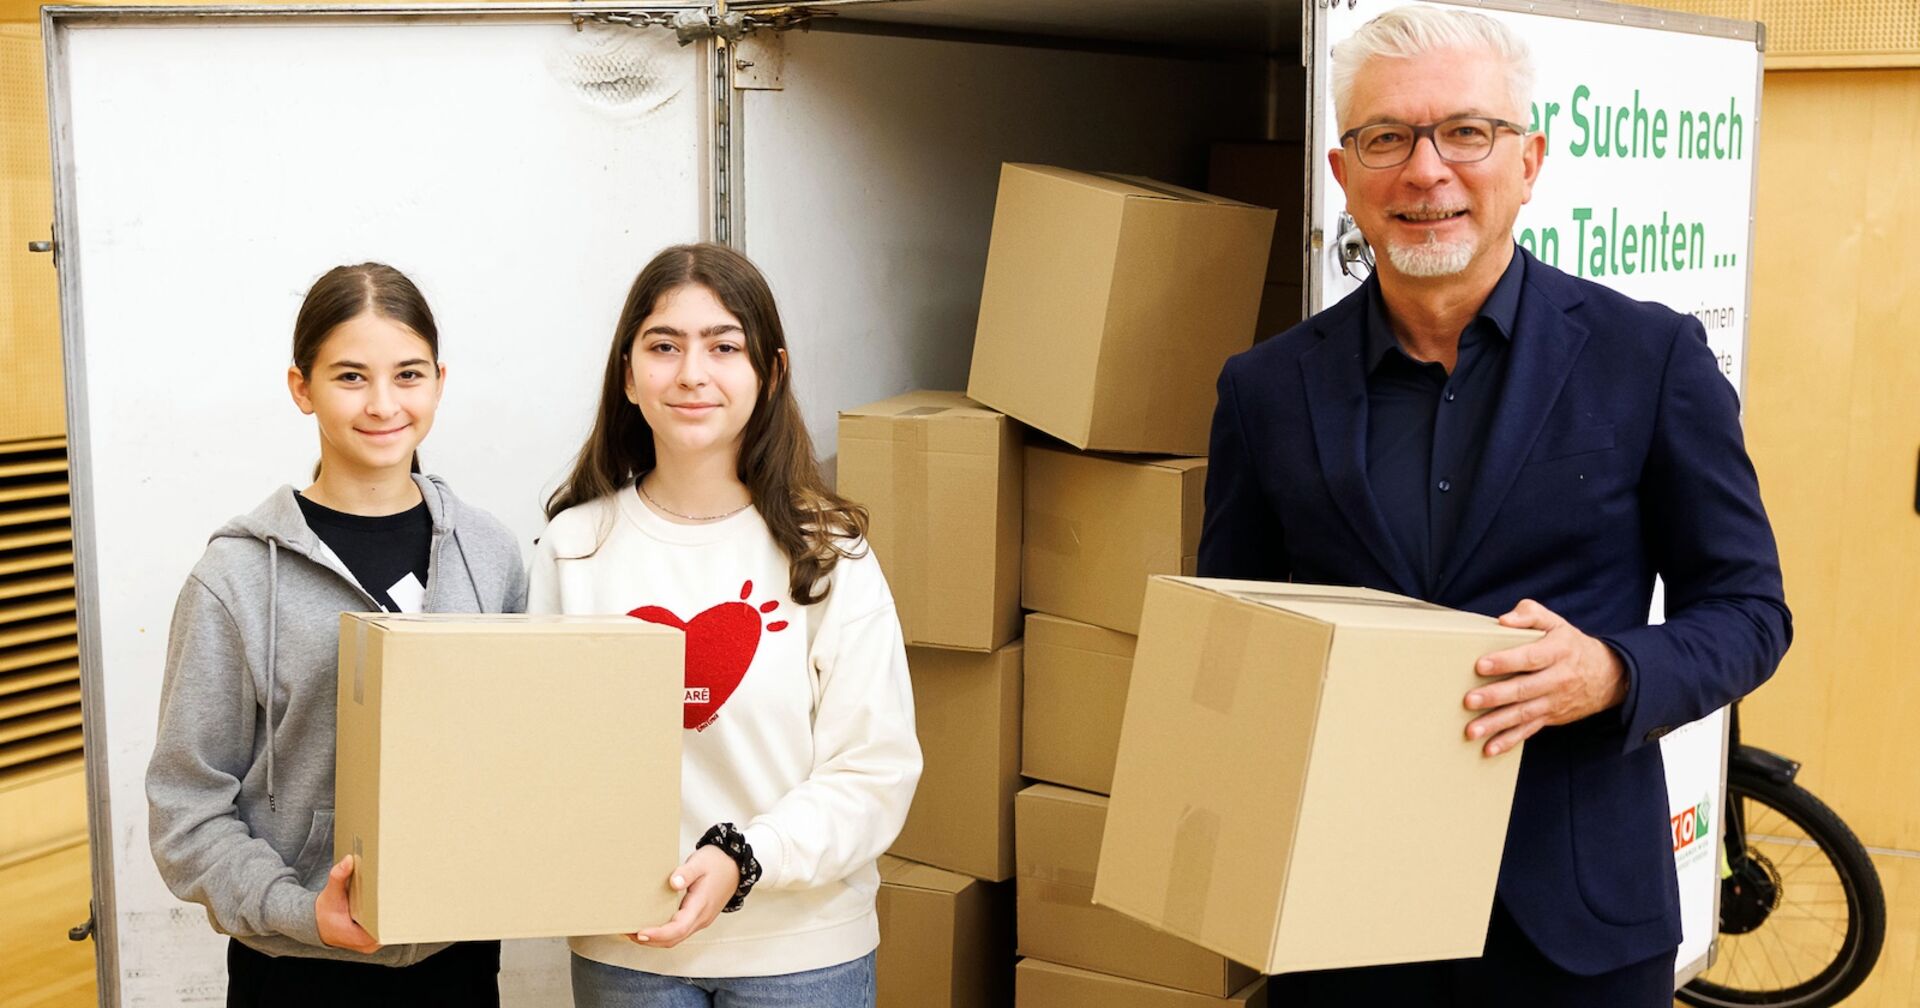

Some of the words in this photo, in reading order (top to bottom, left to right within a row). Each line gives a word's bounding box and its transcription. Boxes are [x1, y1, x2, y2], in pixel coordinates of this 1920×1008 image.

[1569, 85, 1668, 158] Suche
[1678, 96, 1743, 160] nach
[1571, 207, 1705, 278] Talenten
